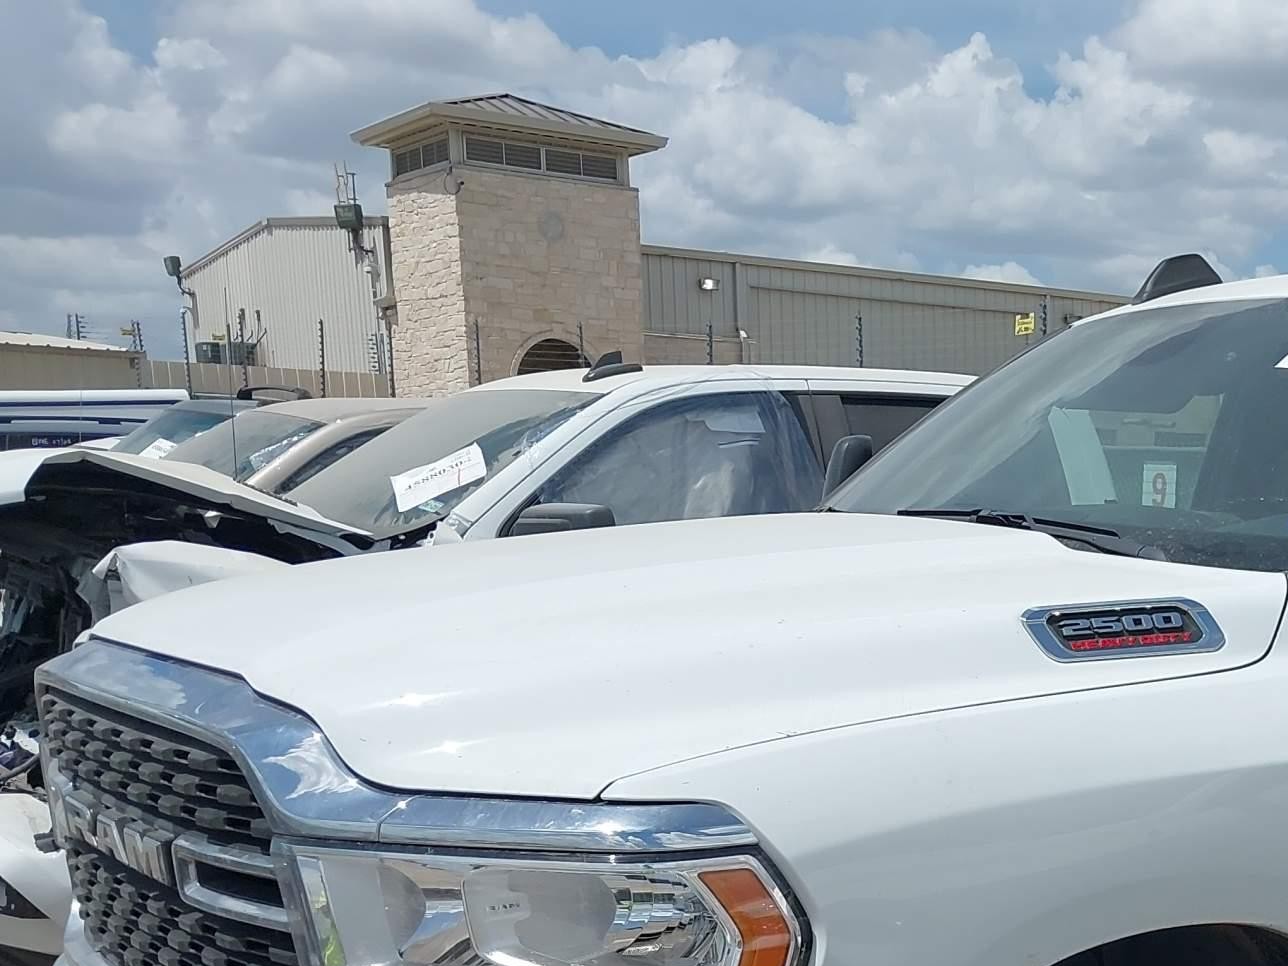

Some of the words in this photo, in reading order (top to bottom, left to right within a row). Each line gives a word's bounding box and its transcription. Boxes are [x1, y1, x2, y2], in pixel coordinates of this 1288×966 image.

[1152, 472, 1168, 507] 9
[1057, 611, 1184, 637] 2500
[64, 795, 172, 887] RAM
